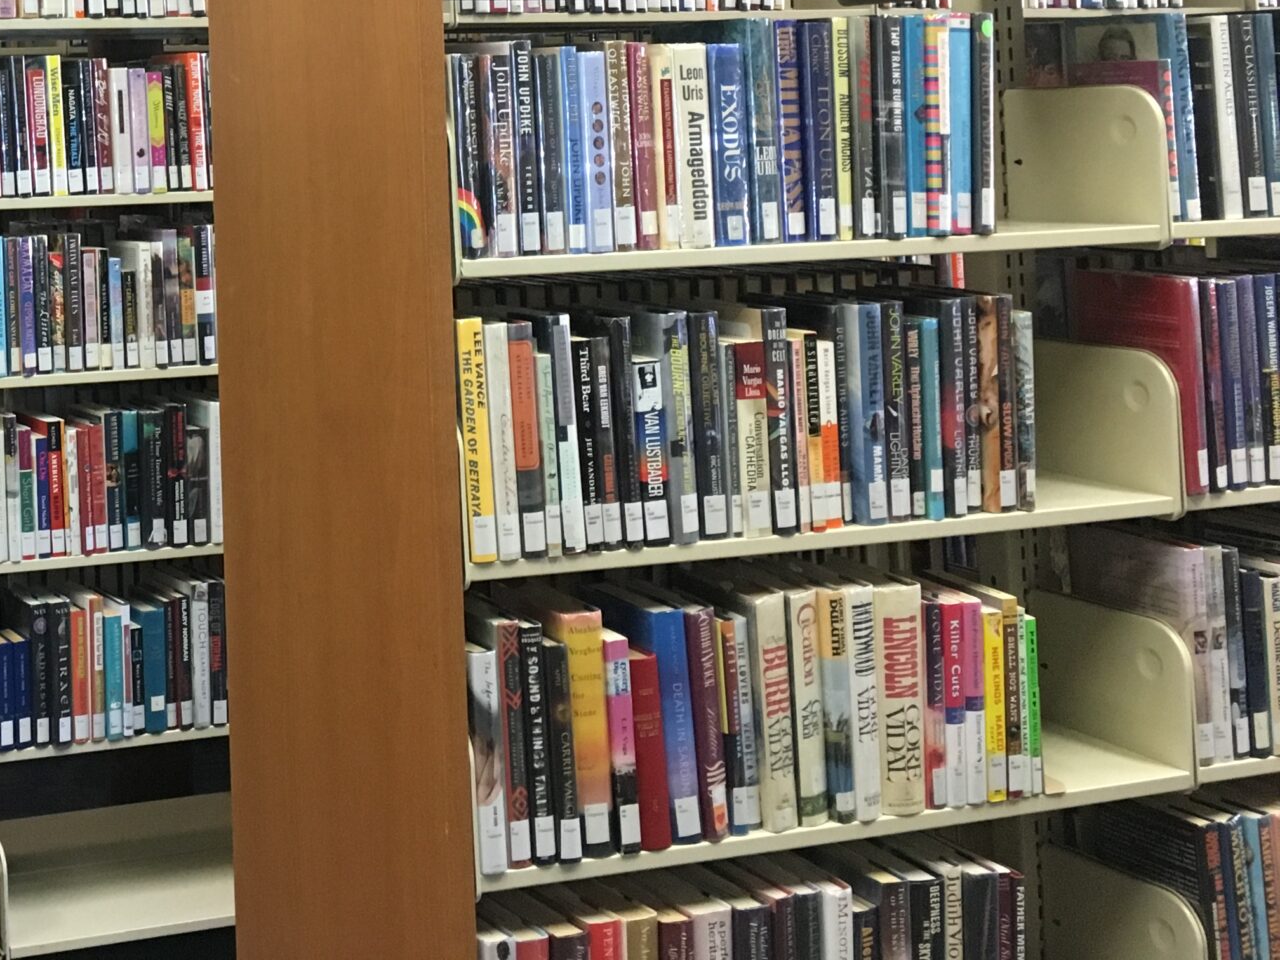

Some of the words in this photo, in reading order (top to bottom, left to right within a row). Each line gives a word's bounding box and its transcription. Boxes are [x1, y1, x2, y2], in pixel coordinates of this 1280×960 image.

[890, 26, 900, 48] TWO
[516, 49, 530, 84] JOHN
[679, 64, 705, 81] Leon
[891, 50, 903, 85] TRAINS
[32, 76, 46, 138] LONDONGRAD
[519, 87, 532, 135] UPDIKE
[682, 85, 704, 101] Uris
[892, 90, 903, 133] RUNNING
[720, 83, 741, 182] EXODUS
[620, 161, 631, 197] JOHN
[686, 111, 708, 221] Armageddon
[1264, 285, 1273, 318] JOSEPH
[473, 331, 483, 360] LEE
[888, 307, 900, 350] JOHN
[952, 303, 962, 352] JOHN
[967, 307, 976, 344] JOHN
[1267, 320, 1278, 371] WAMBAUGH
[461, 350, 472, 375] THE
[578, 347, 591, 382] Third
[892, 351, 904, 405] VARLEY
[969, 348, 979, 399] VARLEY
[463, 379, 475, 435] GARDEN
[475, 362, 486, 410] VANCE
[581, 385, 591, 413] Bear
[776, 369, 786, 408] MARIO
[954, 357, 965, 423] VARLEY
[644, 411, 659, 435] VAN
[778, 413, 788, 459] VARGAS
[1002, 401, 1013, 437] SLOW
[467, 439, 478, 455] OF
[584, 438, 593, 458] JEFF
[646, 437, 664, 497] LUSTBADER
[753, 412, 767, 479] Conversation
[22, 477, 32, 504] Short
[23, 507, 34, 532] Girls
[796, 602, 817, 687] Creation
[829, 600, 841, 657] DULUTH
[851, 602, 876, 678] HOLLYWOOD
[949, 620, 960, 660] Killer
[527, 656, 541, 701] SOUND
[883, 615, 918, 699] LINCOLN
[672, 682, 686, 724] DEATH
[739, 664, 749, 705] LOVERS
[762, 645, 790, 720] BURR
[950, 665, 961, 698] Cuts
[993, 674, 1002, 705] KINGS
[532, 717, 544, 769] THINGS
[676, 728, 686, 740] IN
[768, 718, 784, 780] VIDAL
[885, 705, 907, 783] VIDAL
[905, 704, 922, 781] GORE
